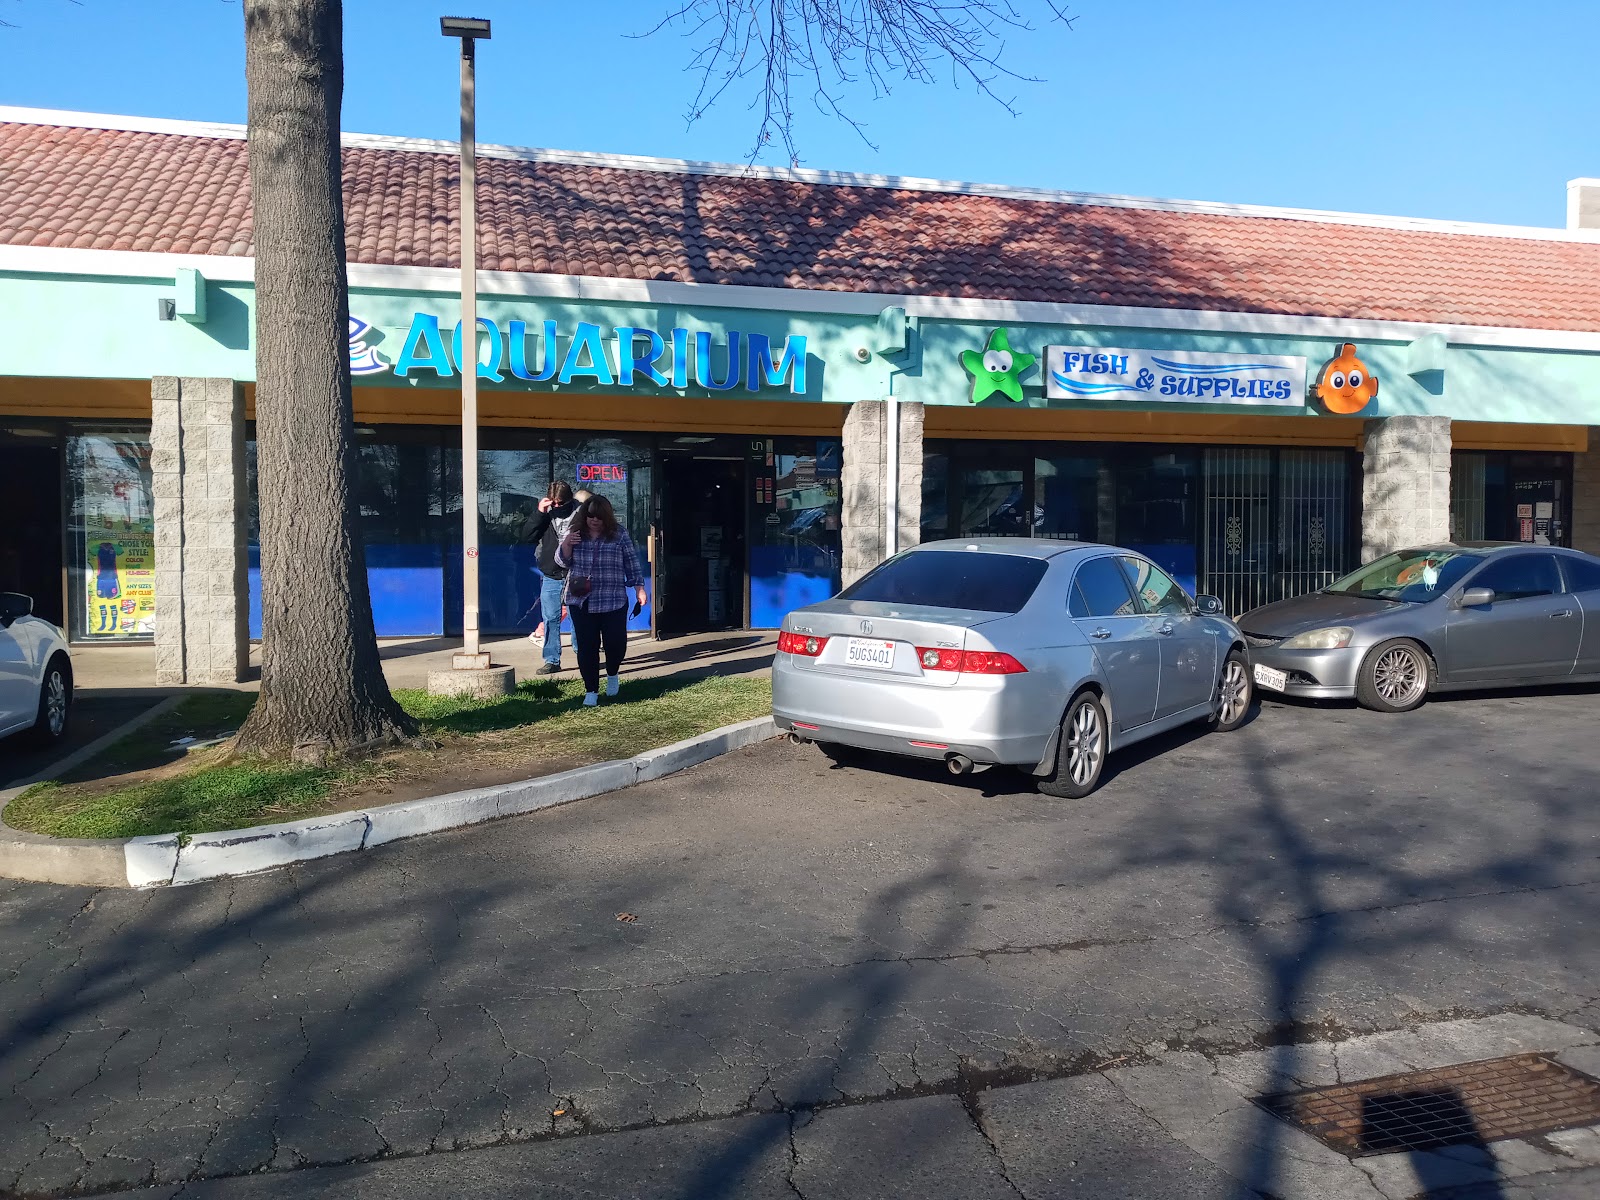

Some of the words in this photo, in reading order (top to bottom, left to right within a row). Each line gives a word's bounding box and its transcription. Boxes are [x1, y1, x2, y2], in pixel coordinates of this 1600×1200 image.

[393, 312, 808, 394] AQUARIUM
[1062, 351, 1129, 375] FISH
[1135, 367, 1155, 390] &
[1160, 376, 1291, 399] SUPPLIES
[579, 465, 624, 480] OPEN
[118, 540, 140, 548] CHOSE
[849, 646, 890, 664] 5UGS401
